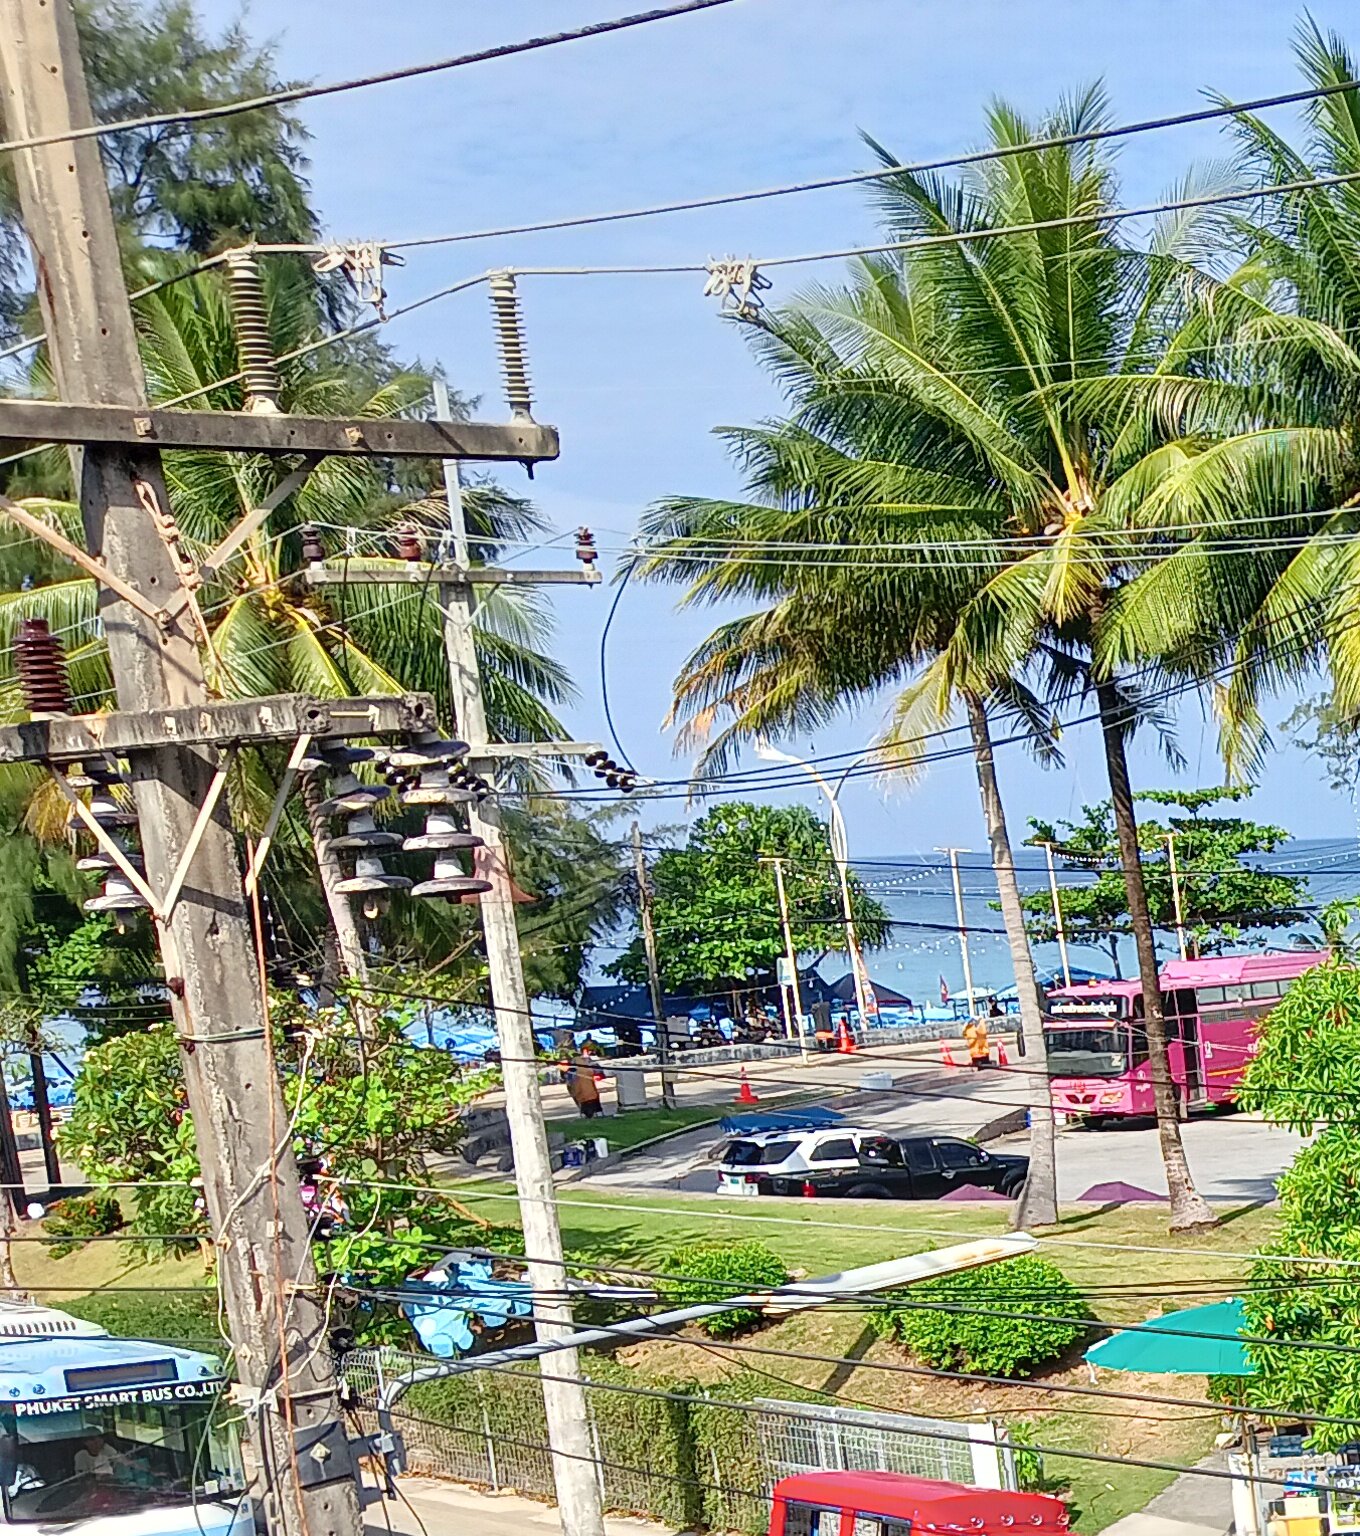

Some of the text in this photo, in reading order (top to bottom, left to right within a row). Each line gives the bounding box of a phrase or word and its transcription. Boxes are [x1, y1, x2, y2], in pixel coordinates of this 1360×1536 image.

[14, 1399, 81, 1417] PHUKET
[85, 1391, 139, 1409] SMART
[141, 1386, 173, 1403] BUS
